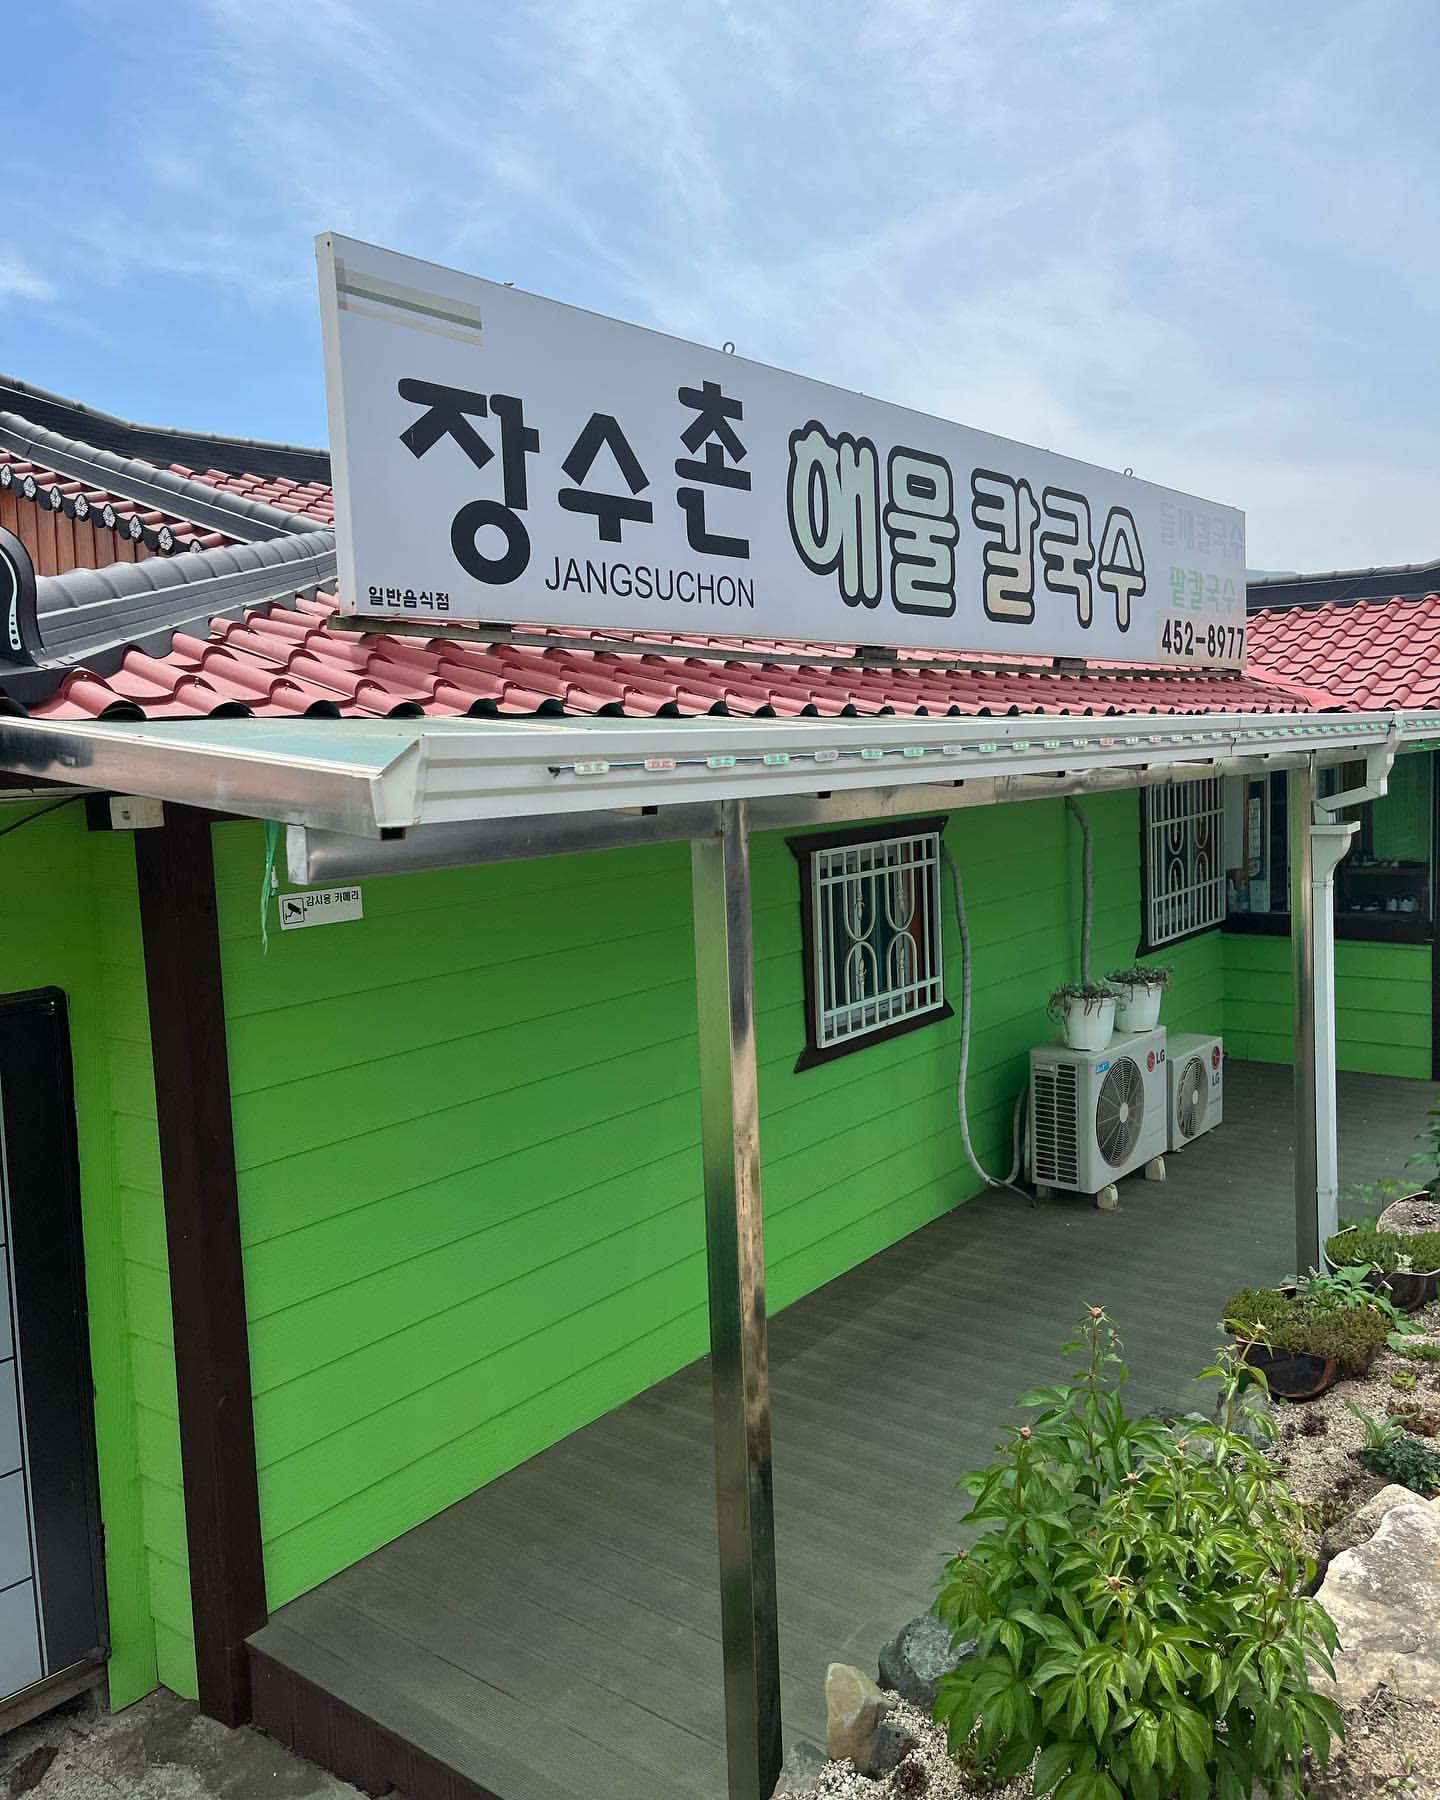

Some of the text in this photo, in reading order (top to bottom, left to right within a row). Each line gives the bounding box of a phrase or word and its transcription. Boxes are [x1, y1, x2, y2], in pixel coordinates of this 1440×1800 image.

[397, 377, 751, 585] 장수촌
[545, 557, 755, 608] JANGSUCHON
[368, 586, 450, 611] 일반음식점
[1161, 618, 1245, 660] 452-8977
[306, 893, 331, 907] 감시용
[1156, 1049, 1165, 1065] LG
[1212, 1071, 1220, 1086] LG
